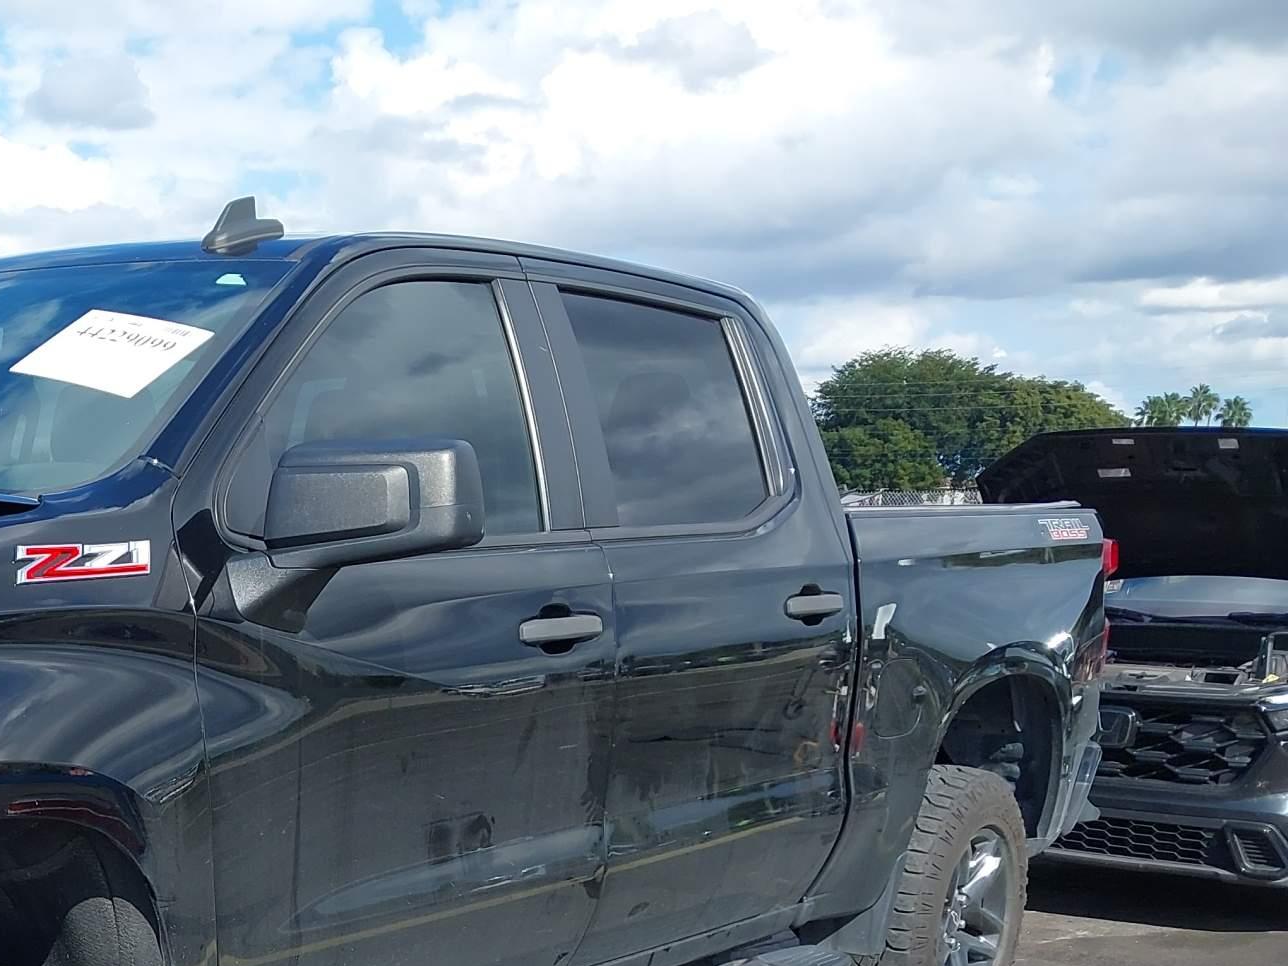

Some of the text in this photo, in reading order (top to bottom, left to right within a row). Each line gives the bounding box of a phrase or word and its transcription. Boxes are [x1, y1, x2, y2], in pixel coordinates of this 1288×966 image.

[76, 326, 178, 352] 44229099
[1037, 518, 1090, 531] TRAIL
[1050, 529, 1088, 541] BOSS
[16, 540, 151, 584] Z71
